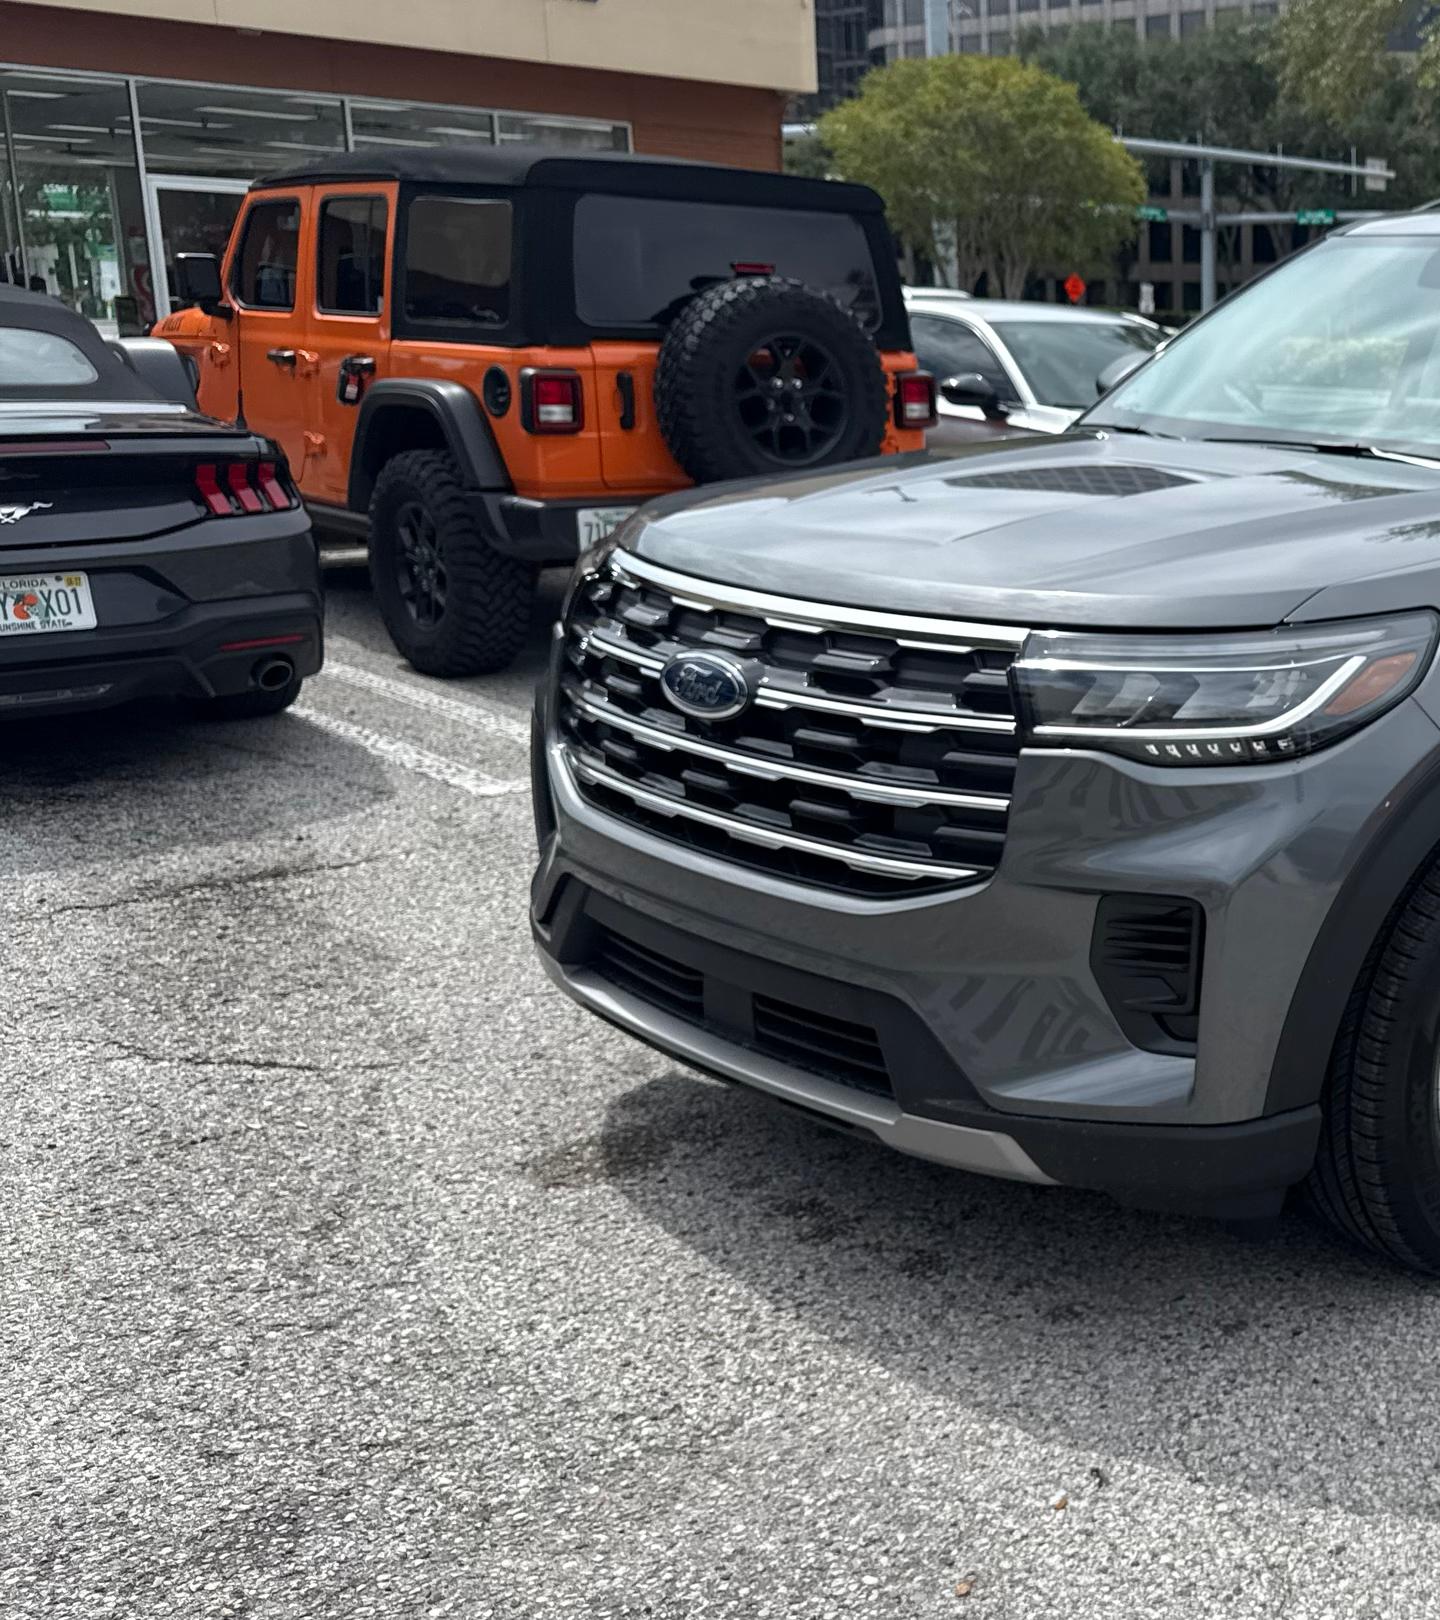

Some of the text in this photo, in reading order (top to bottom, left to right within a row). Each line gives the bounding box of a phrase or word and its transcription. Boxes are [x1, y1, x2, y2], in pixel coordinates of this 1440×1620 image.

[0, 579, 47, 590] LORIDA
[39, 587, 82, 617] X01
[674, 663, 722, 704] Ford
